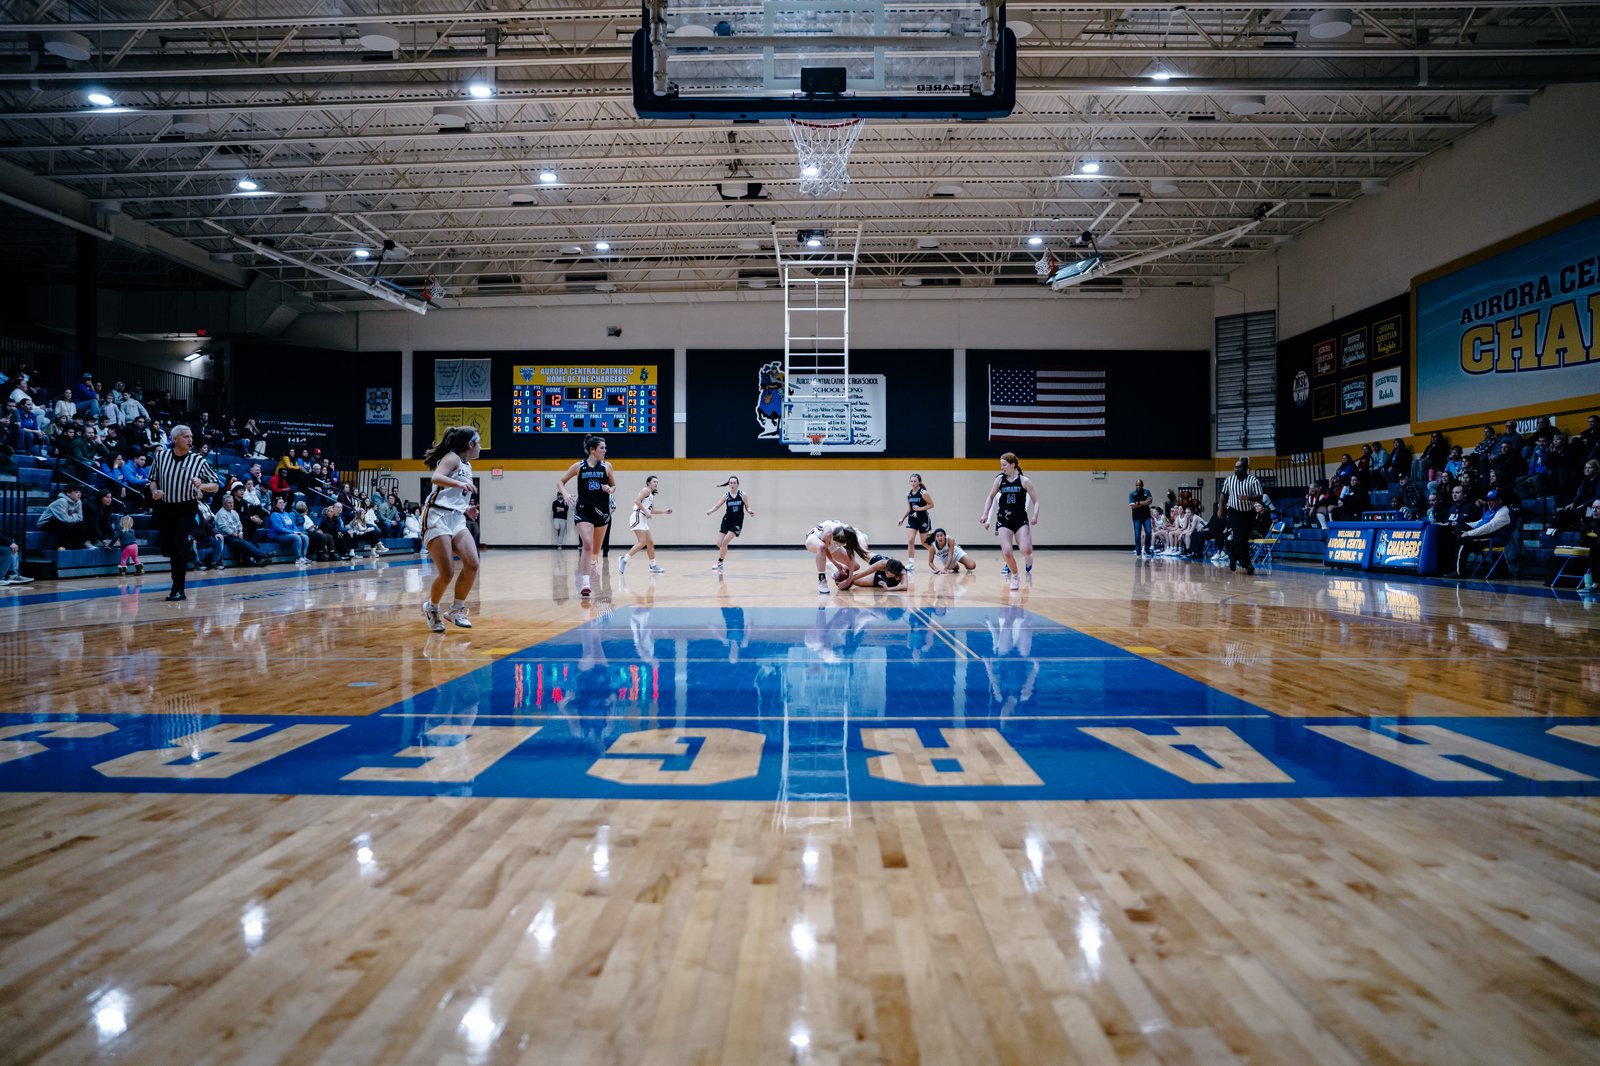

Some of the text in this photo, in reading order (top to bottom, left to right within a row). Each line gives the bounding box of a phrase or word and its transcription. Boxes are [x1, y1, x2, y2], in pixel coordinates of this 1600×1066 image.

[1460, 254, 1600, 326] AURORA CE
[1377, 339, 1396, 354] Knights
[540, 367, 567, 375] AURORA
[569, 367, 599, 375] CENTRAL
[600, 367, 634, 375] CATHOLIC
[546, 375, 628, 383] HOME OF THE CHARGERS
[852, 377, 862, 385] HIGH
[862, 377, 879, 385] SCHOOL
[1378, 388, 1394, 400] Rebels
[551, 395, 562, 406] 12
[617, 395, 625, 406] 4
[1344, 398, 1362, 411] Knights
[550, 418, 556, 428] 3
[618, 418, 625, 428] 2
[587, 478, 601, 491] 20
[1391, 531, 1405, 539] HOME
[1412, 531, 1421, 539] THE
[1327, 537, 1366, 549] AURORA CENTRAL
[1386, 540, 1422, 558] CHARGERS
[1334, 550, 1357, 561] CATHOLIC
